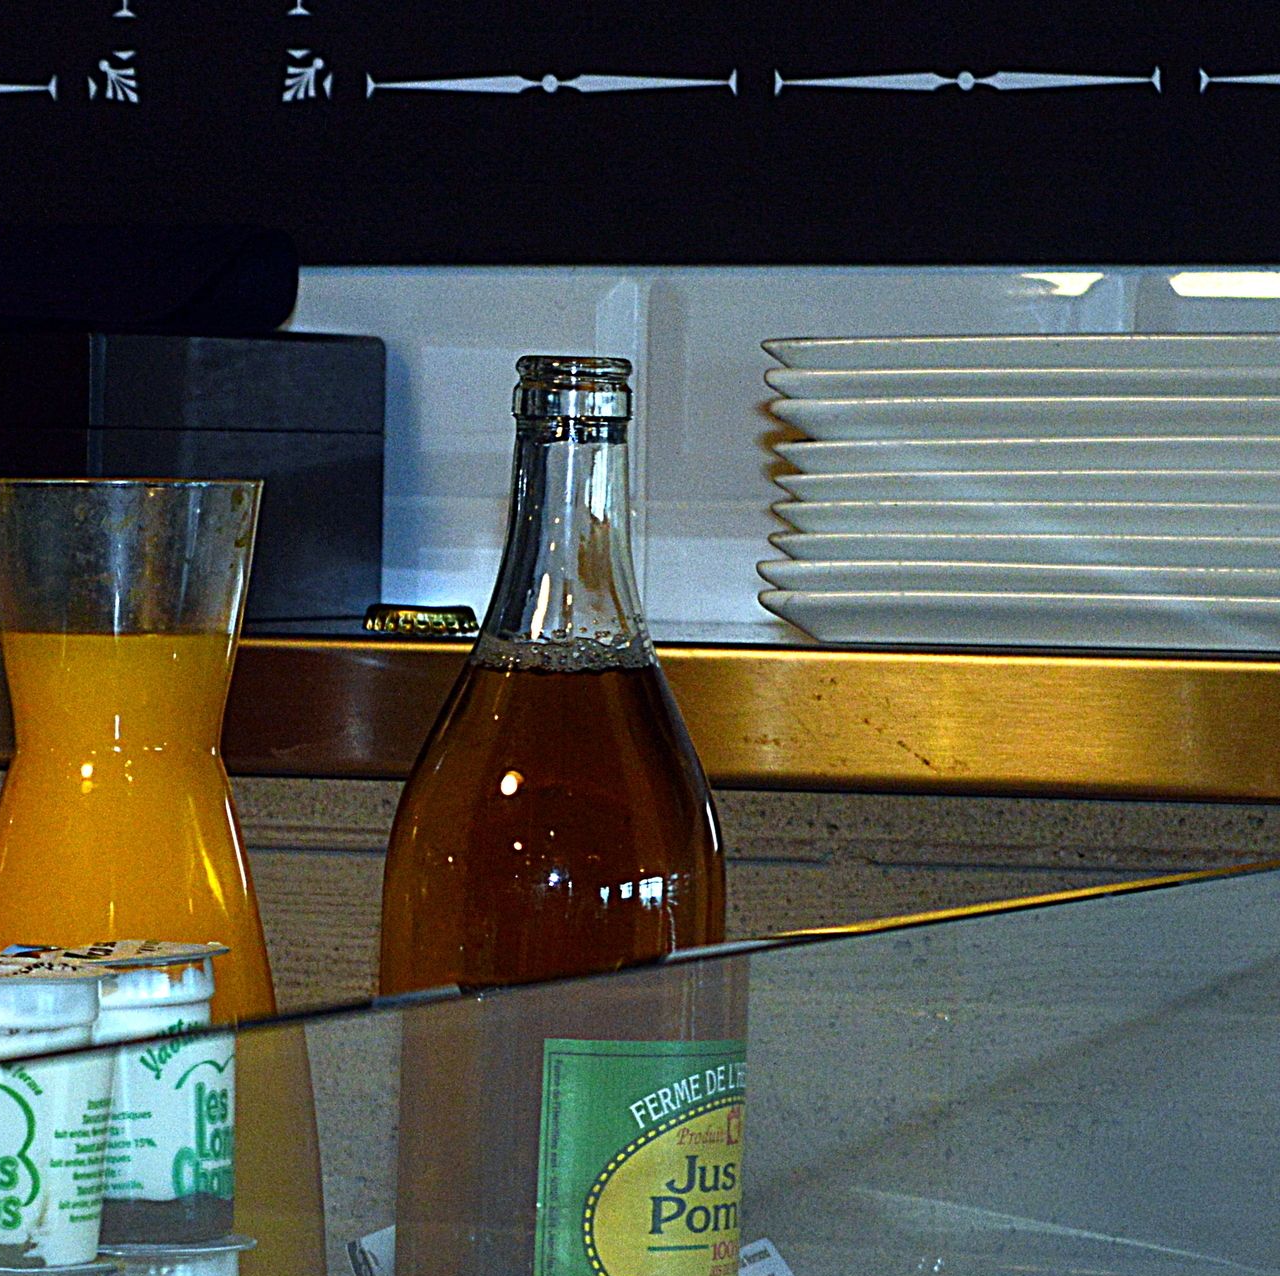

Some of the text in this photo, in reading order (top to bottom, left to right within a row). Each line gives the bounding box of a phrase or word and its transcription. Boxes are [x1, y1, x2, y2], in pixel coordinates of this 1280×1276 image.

[630, 1076, 701, 1129] FERME
[705, 1065, 726, 1094] DE
[666, 1155, 736, 1195] Jus
[648, 1195, 738, 1236] Pom
[709, 1241, 739, 1261] 100
